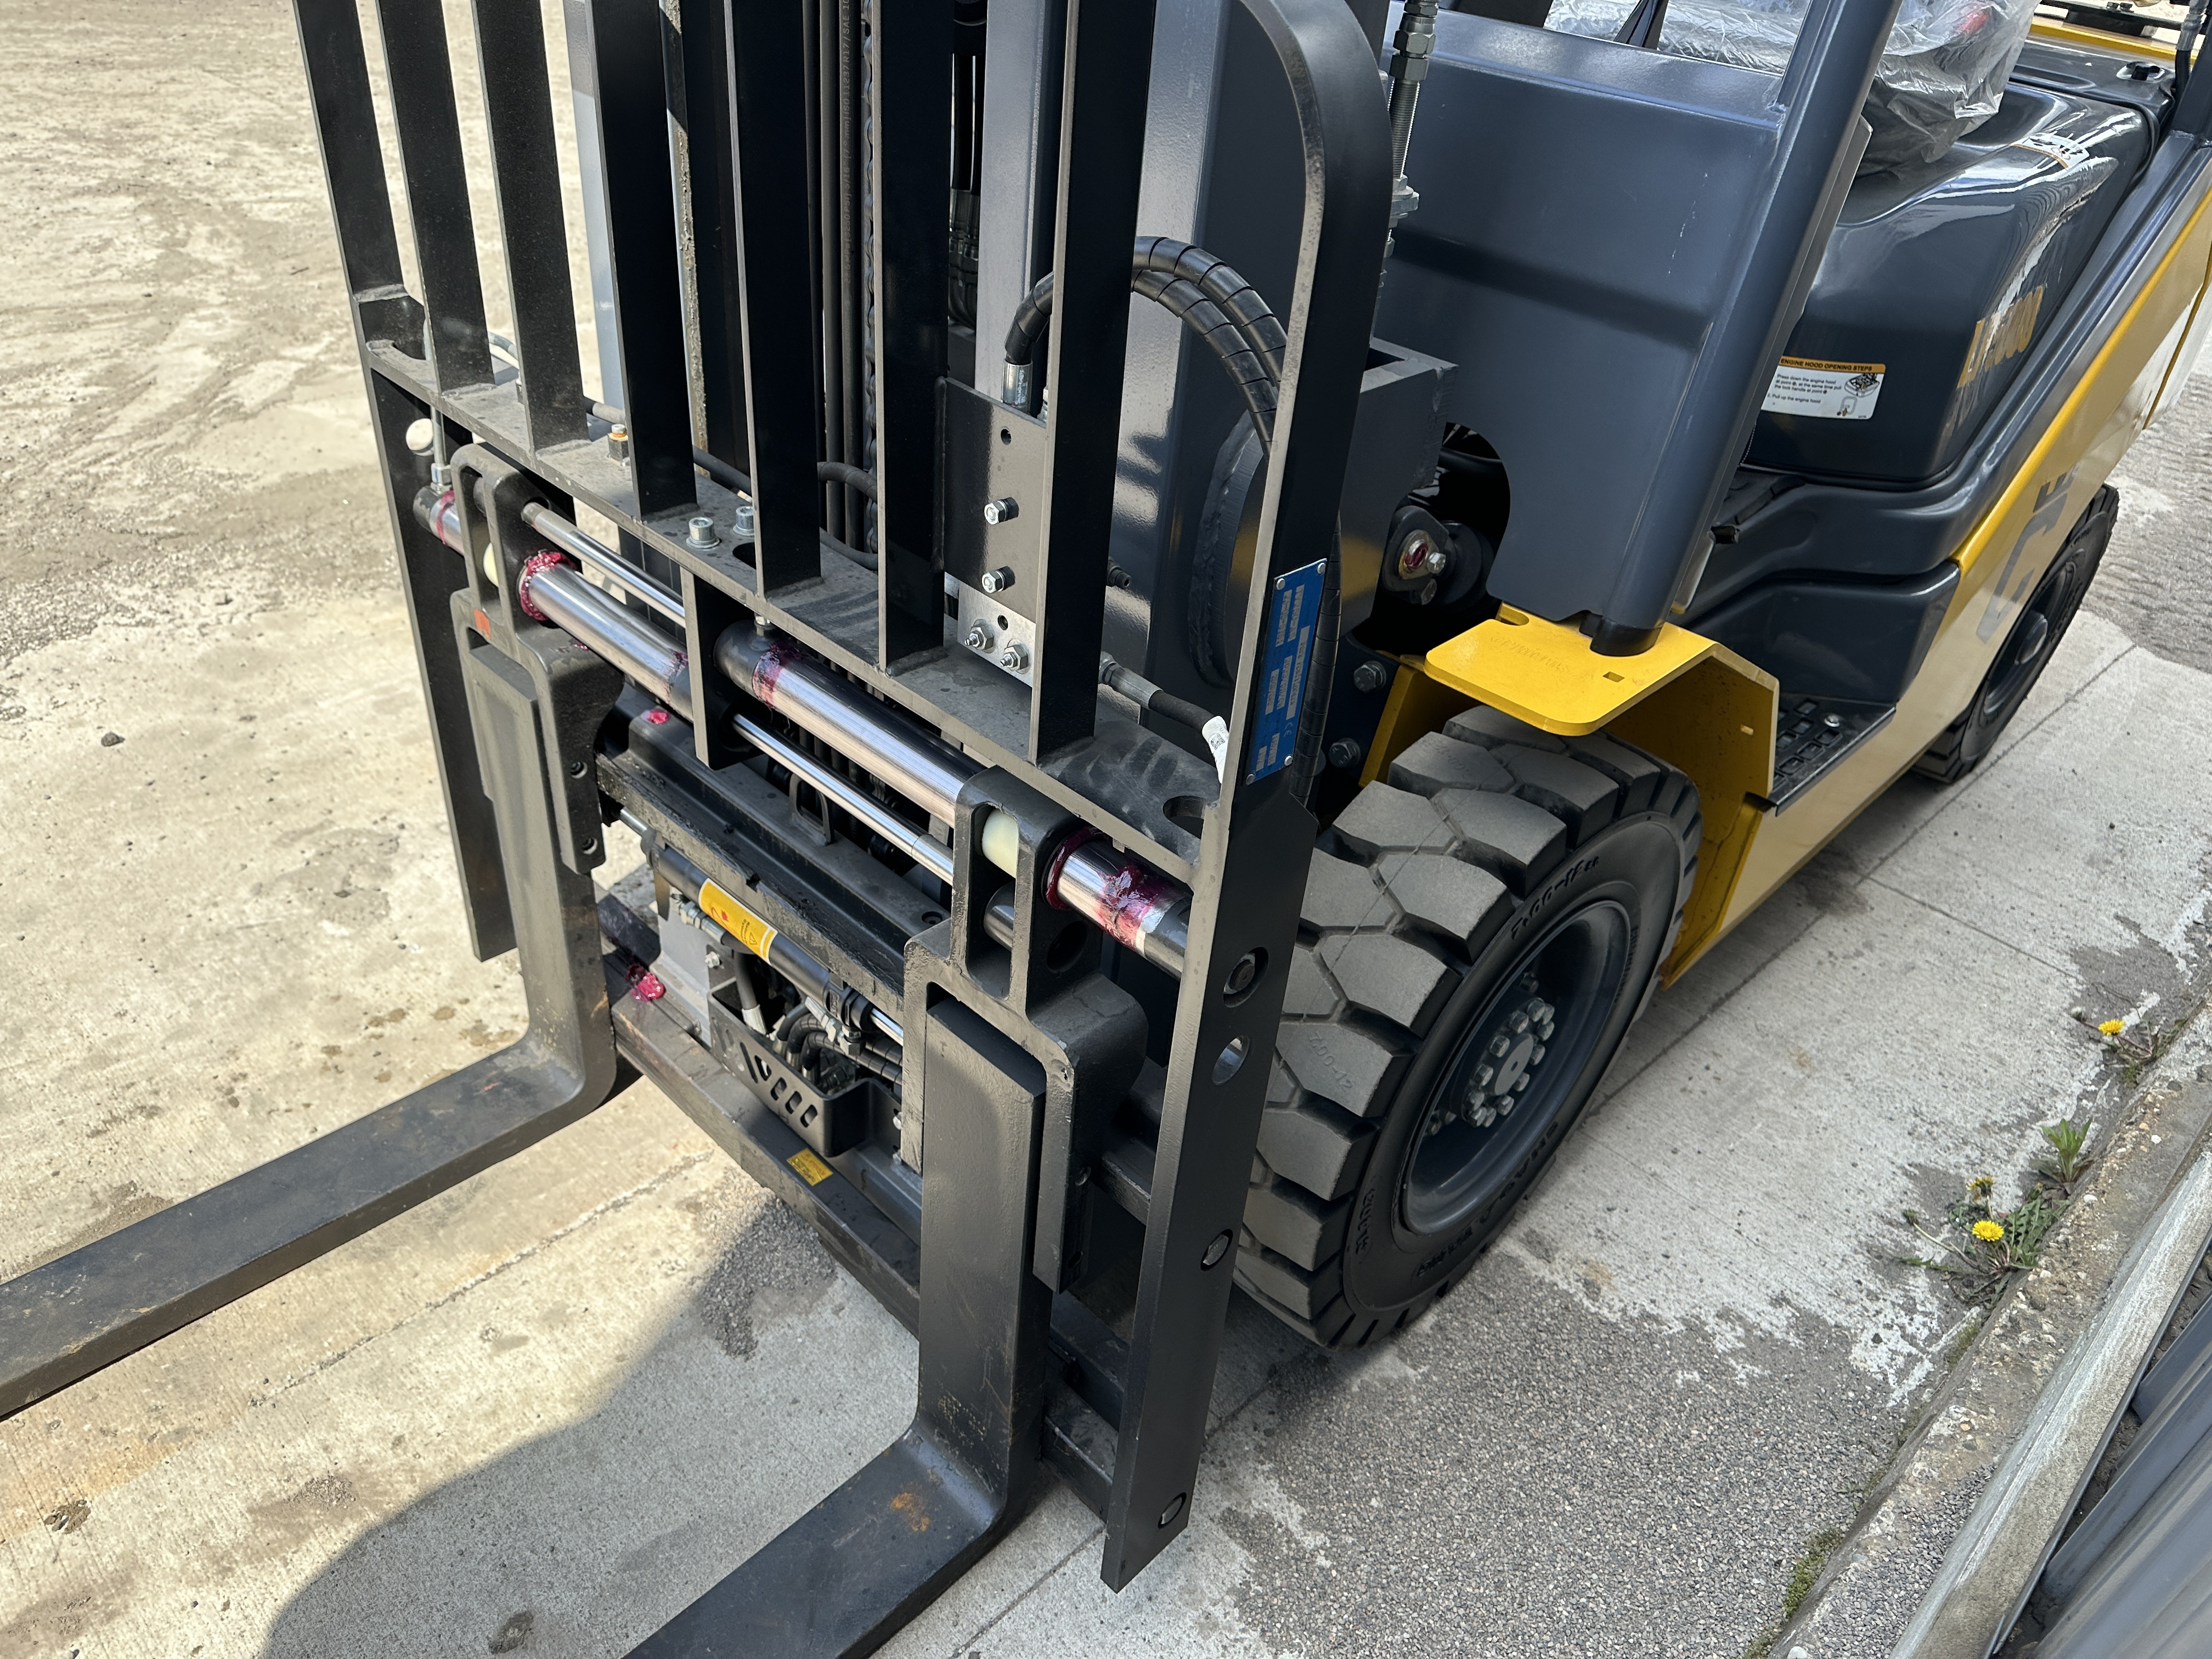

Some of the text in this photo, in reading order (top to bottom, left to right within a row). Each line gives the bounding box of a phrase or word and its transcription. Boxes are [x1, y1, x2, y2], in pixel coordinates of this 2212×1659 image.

[842, 44, 850, 63] R17
[1780, 358, 1803, 367] ENGINE
[1804, 360, 1824, 369] HOOD
[1824, 362, 1852, 371] OPENING
[1308, 1032, 1352, 1091] 7.00-12
